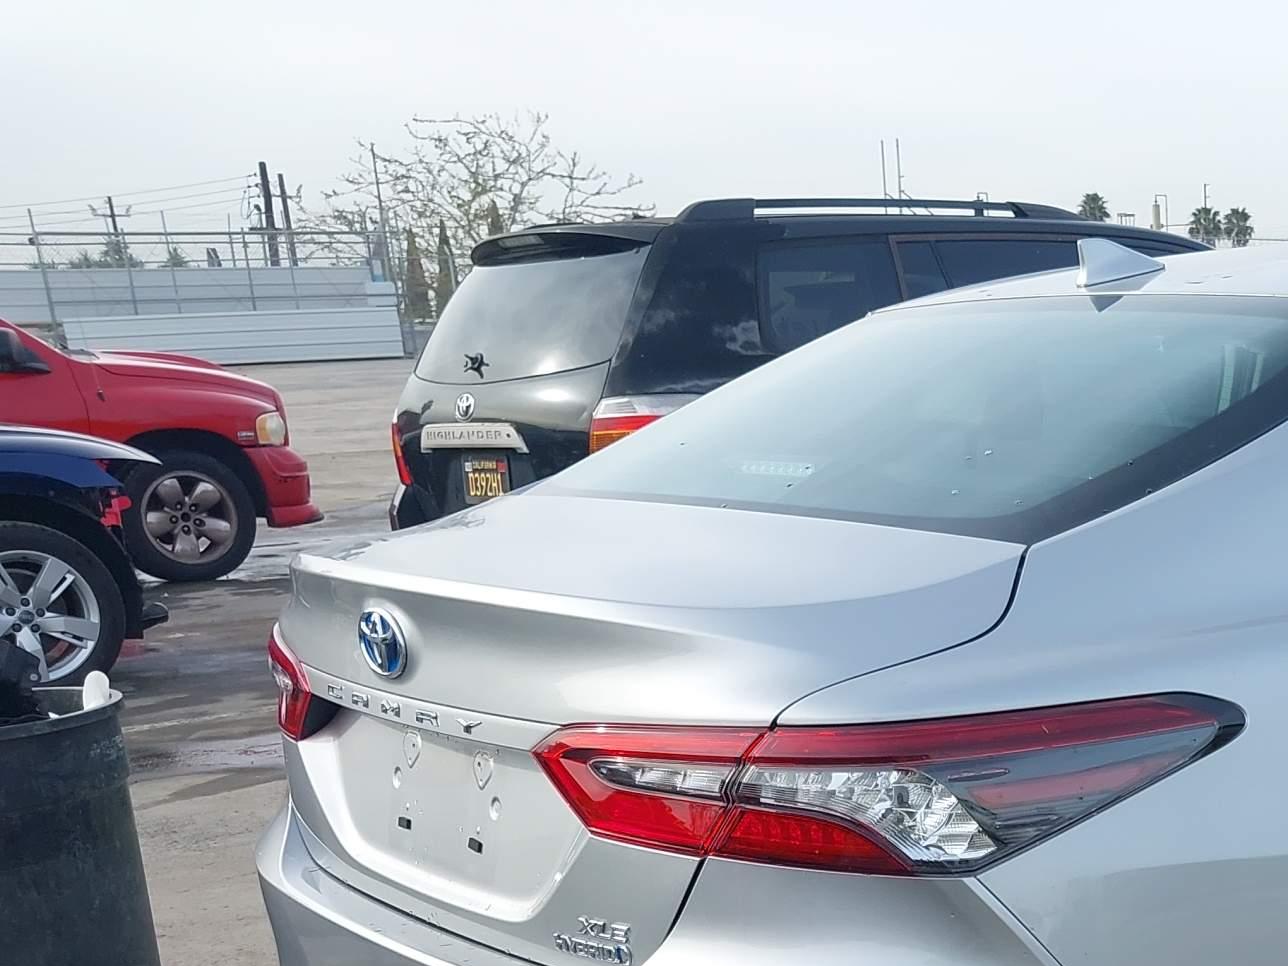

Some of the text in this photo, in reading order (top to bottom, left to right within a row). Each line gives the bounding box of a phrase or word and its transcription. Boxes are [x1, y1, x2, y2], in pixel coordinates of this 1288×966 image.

[426, 430, 502, 441] HIGHLANDER
[327, 684, 482, 734] CAMRY
[576, 915, 631, 943] XLE
[553, 932, 632, 966] HYBRID
